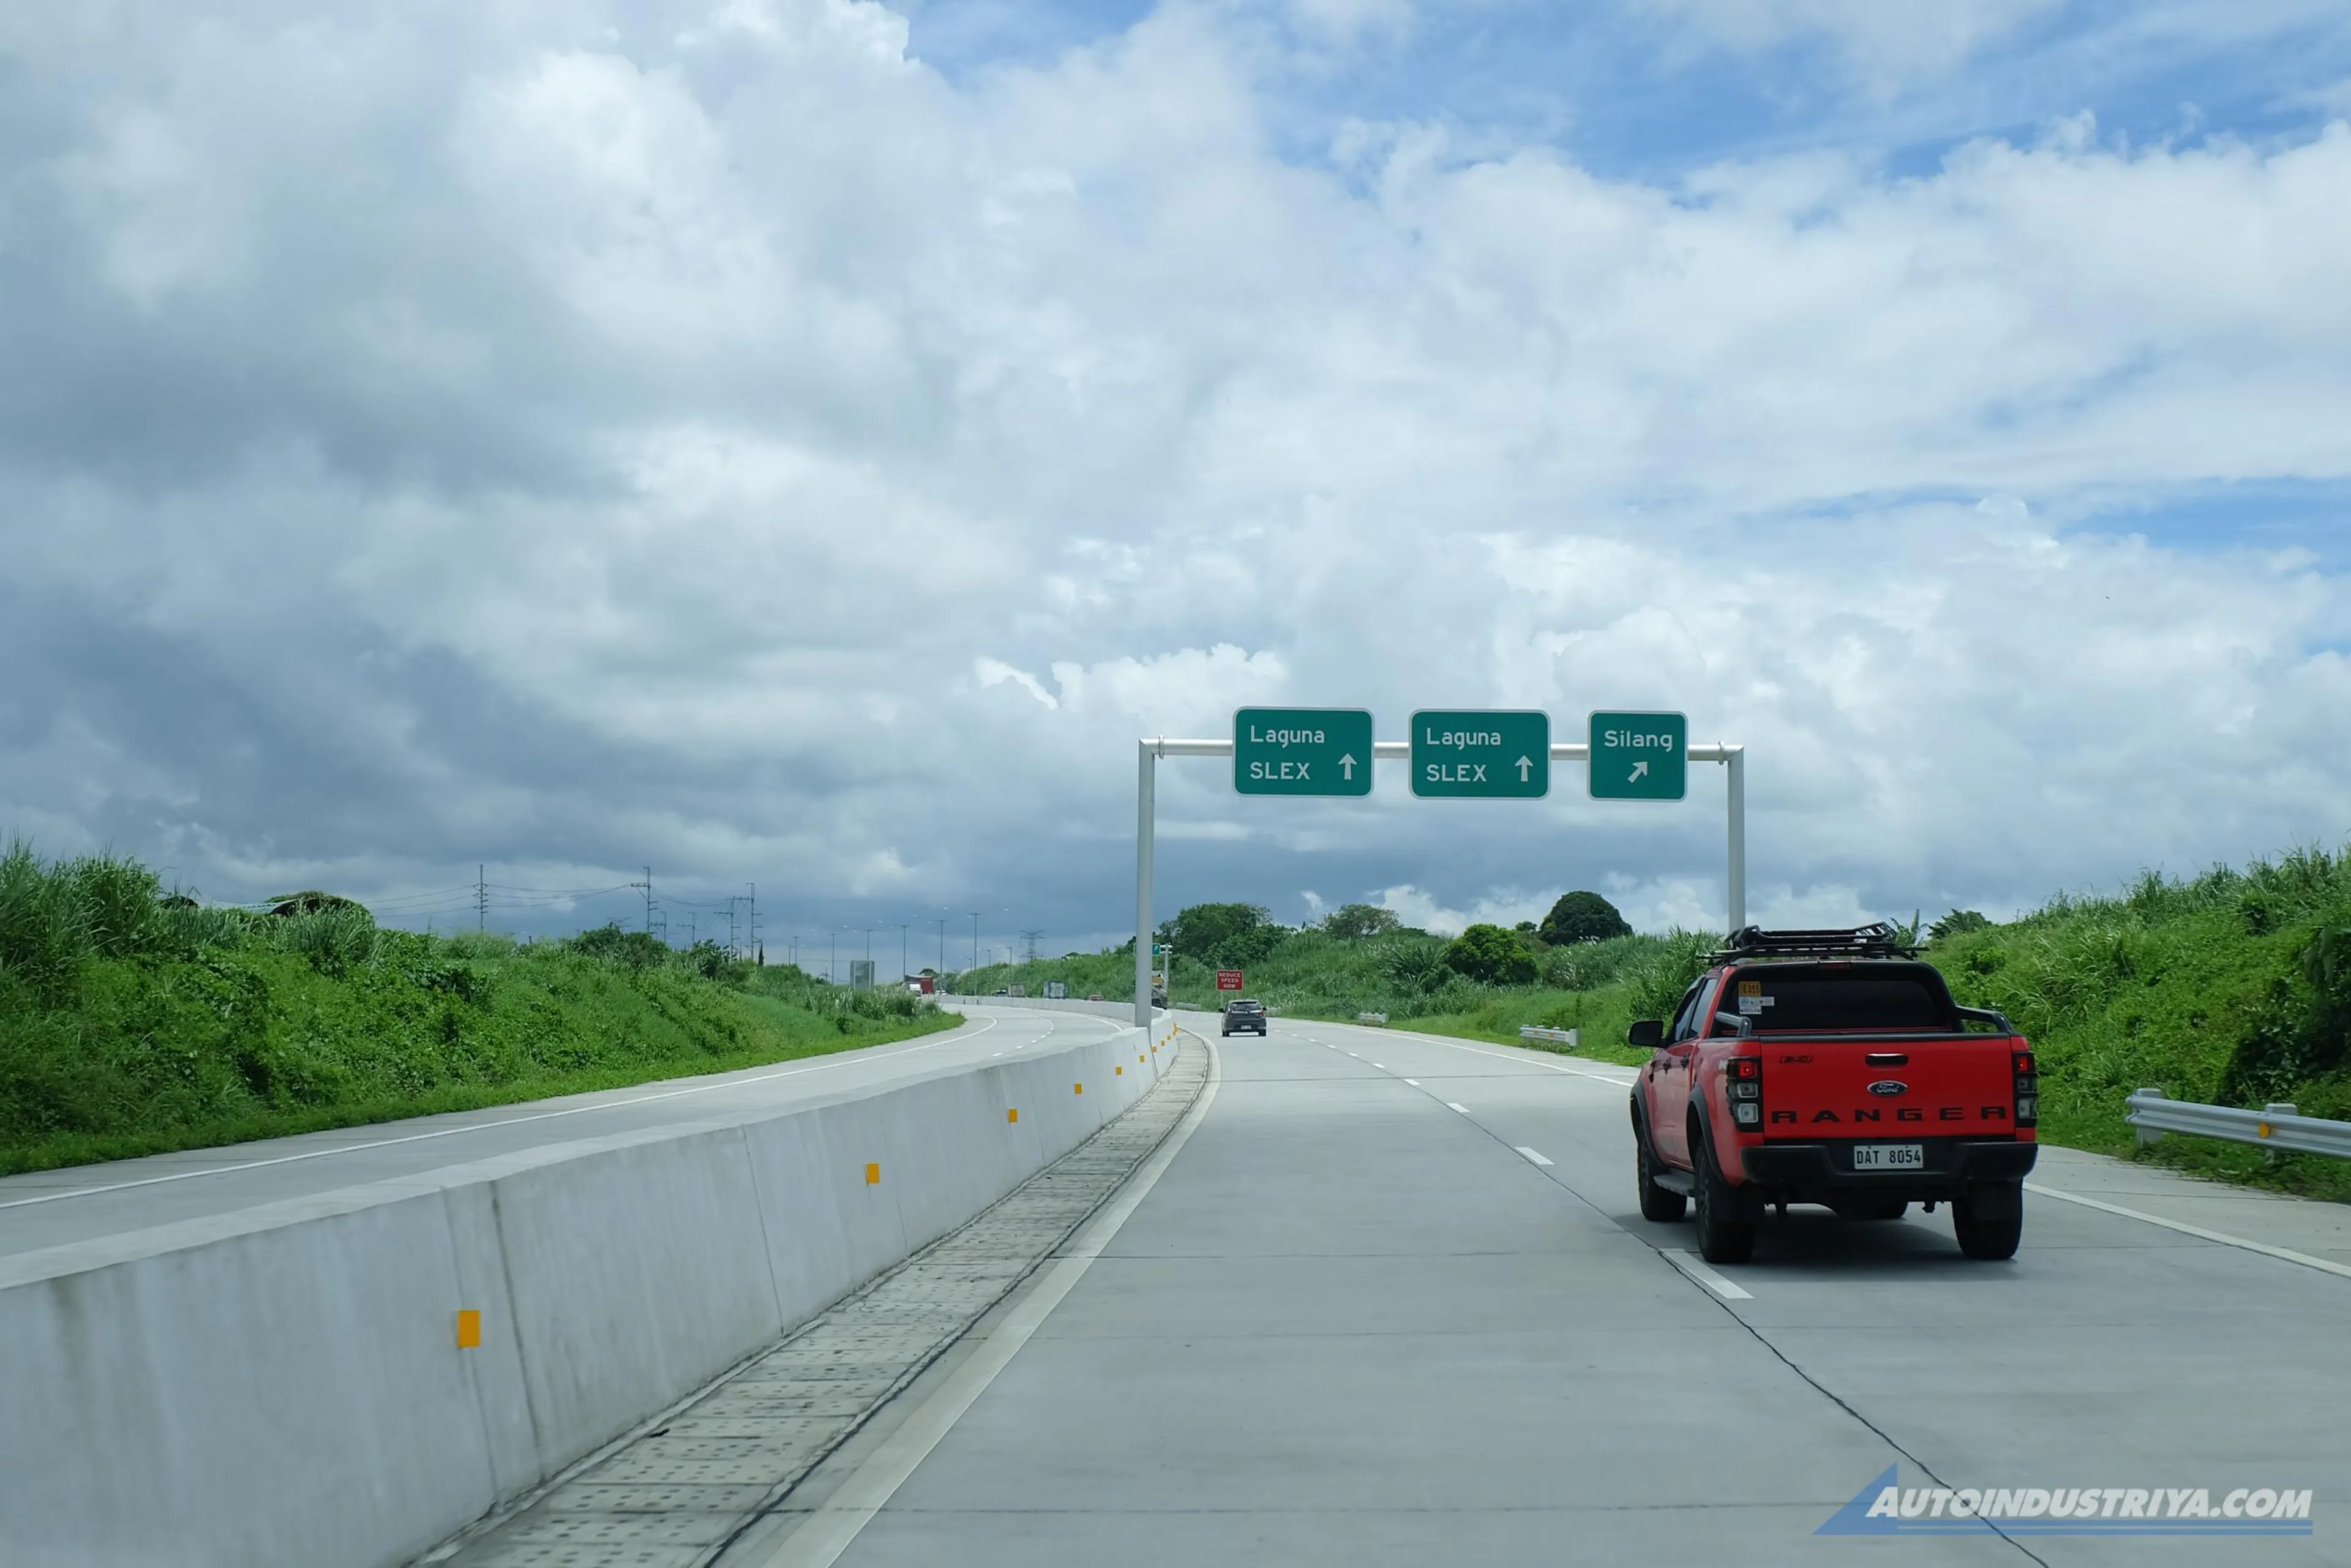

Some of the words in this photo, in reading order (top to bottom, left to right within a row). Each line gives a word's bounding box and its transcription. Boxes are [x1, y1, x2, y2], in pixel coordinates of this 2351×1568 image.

[1250, 725, 1325, 748] Laguna
[1426, 727, 1501, 750] Laguna
[1603, 730, 1673, 752] Silang
[1250, 762, 1310, 780] SLEX
[1426, 764, 1487, 782] SLEX
[1877, 1082, 1900, 1093] Ford
[1771, 1106, 2007, 1123] RANGER
[1856, 1150, 1880, 1164] DAT
[1889, 1149, 1921, 1164] 8054
